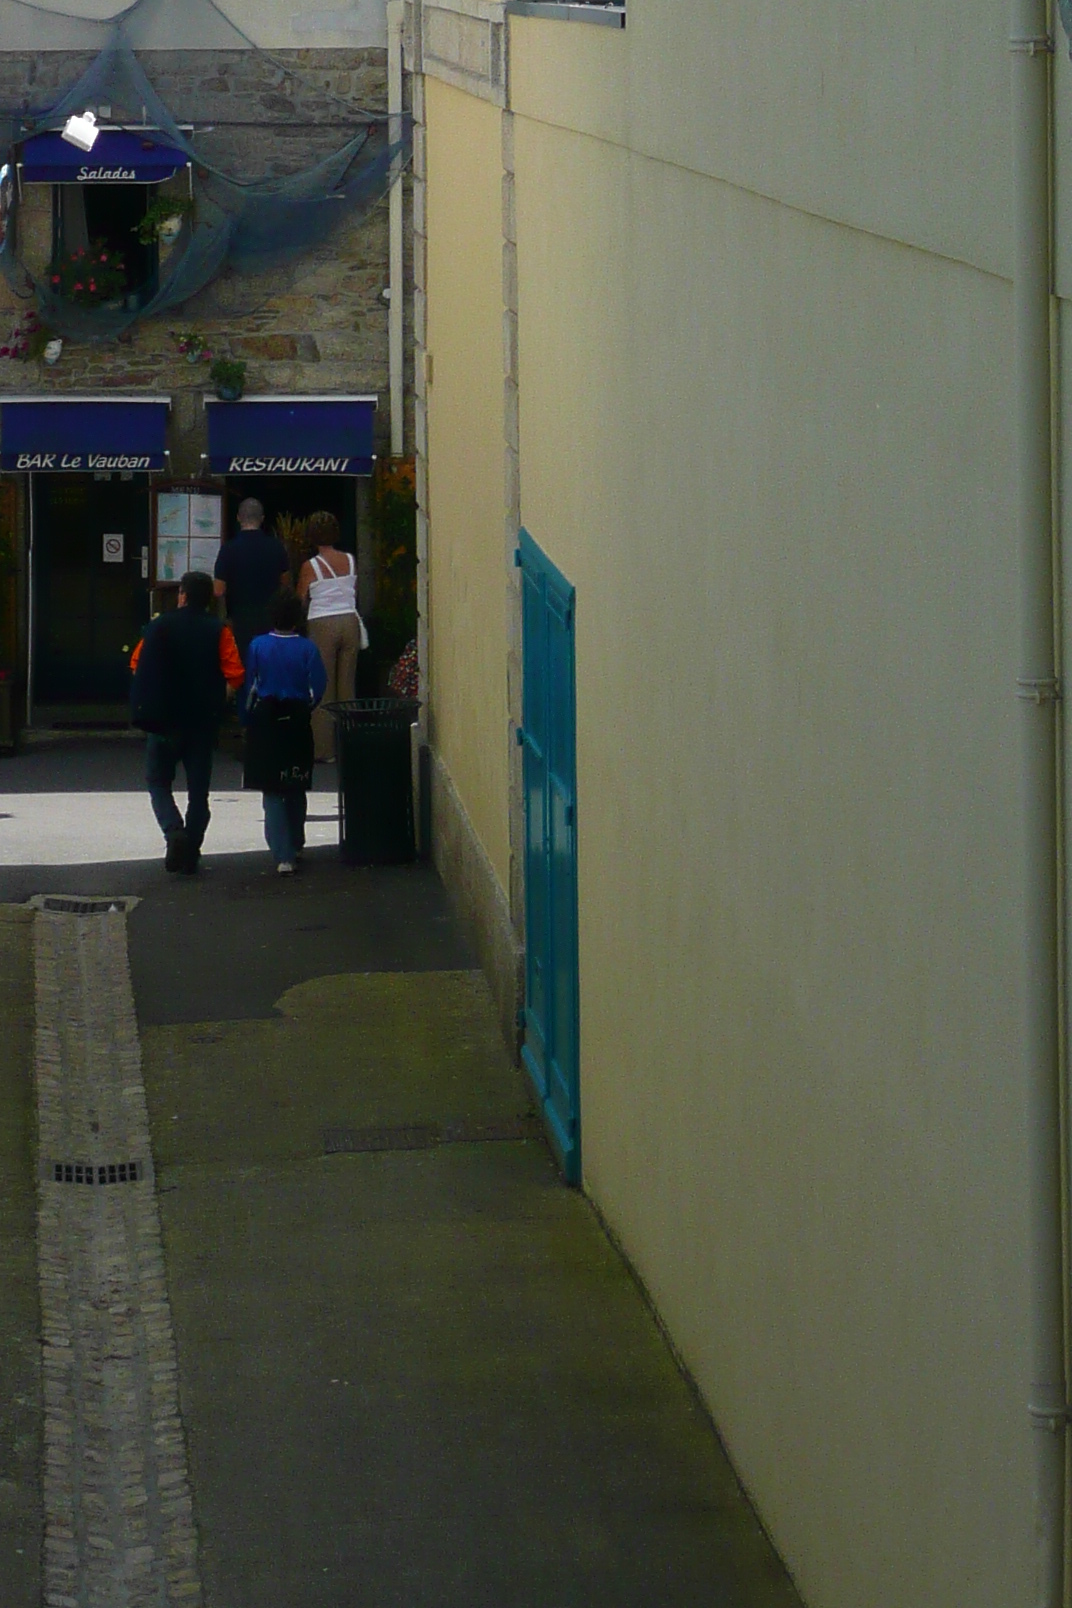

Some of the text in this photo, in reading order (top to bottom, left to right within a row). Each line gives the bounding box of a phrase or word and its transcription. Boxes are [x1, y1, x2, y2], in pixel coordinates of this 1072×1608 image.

[76, 166, 136, 181] Salades
[16, 453, 150, 469] BAR Le Vauban
[229, 457, 349, 472] RESTAURANT
